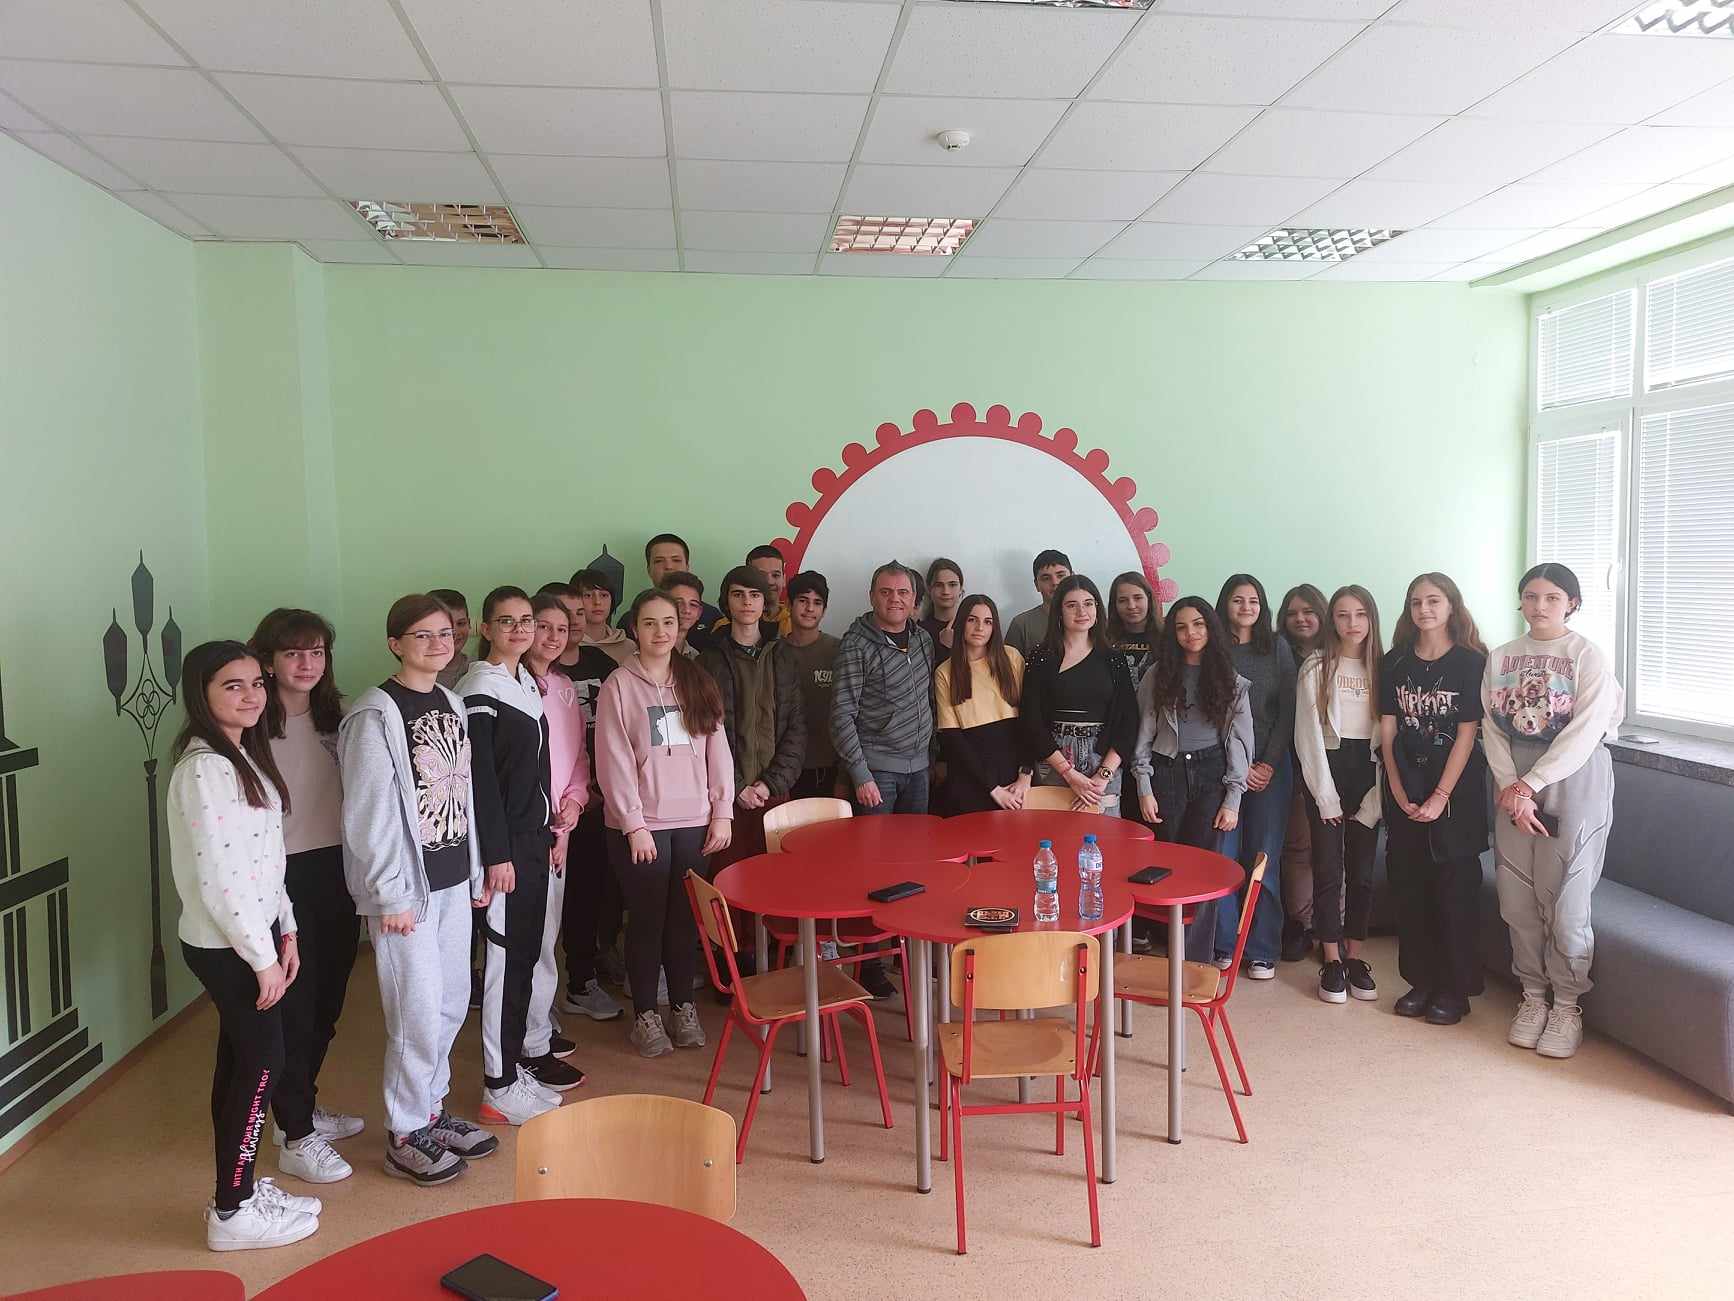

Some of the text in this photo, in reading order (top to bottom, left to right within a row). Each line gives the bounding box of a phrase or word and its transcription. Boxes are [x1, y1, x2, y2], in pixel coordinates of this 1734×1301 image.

[1500, 654, 1574, 680] ADVENTURE
[233, 1167, 244, 1189] WITH
[248, 1095, 262, 1123] MIGHT
